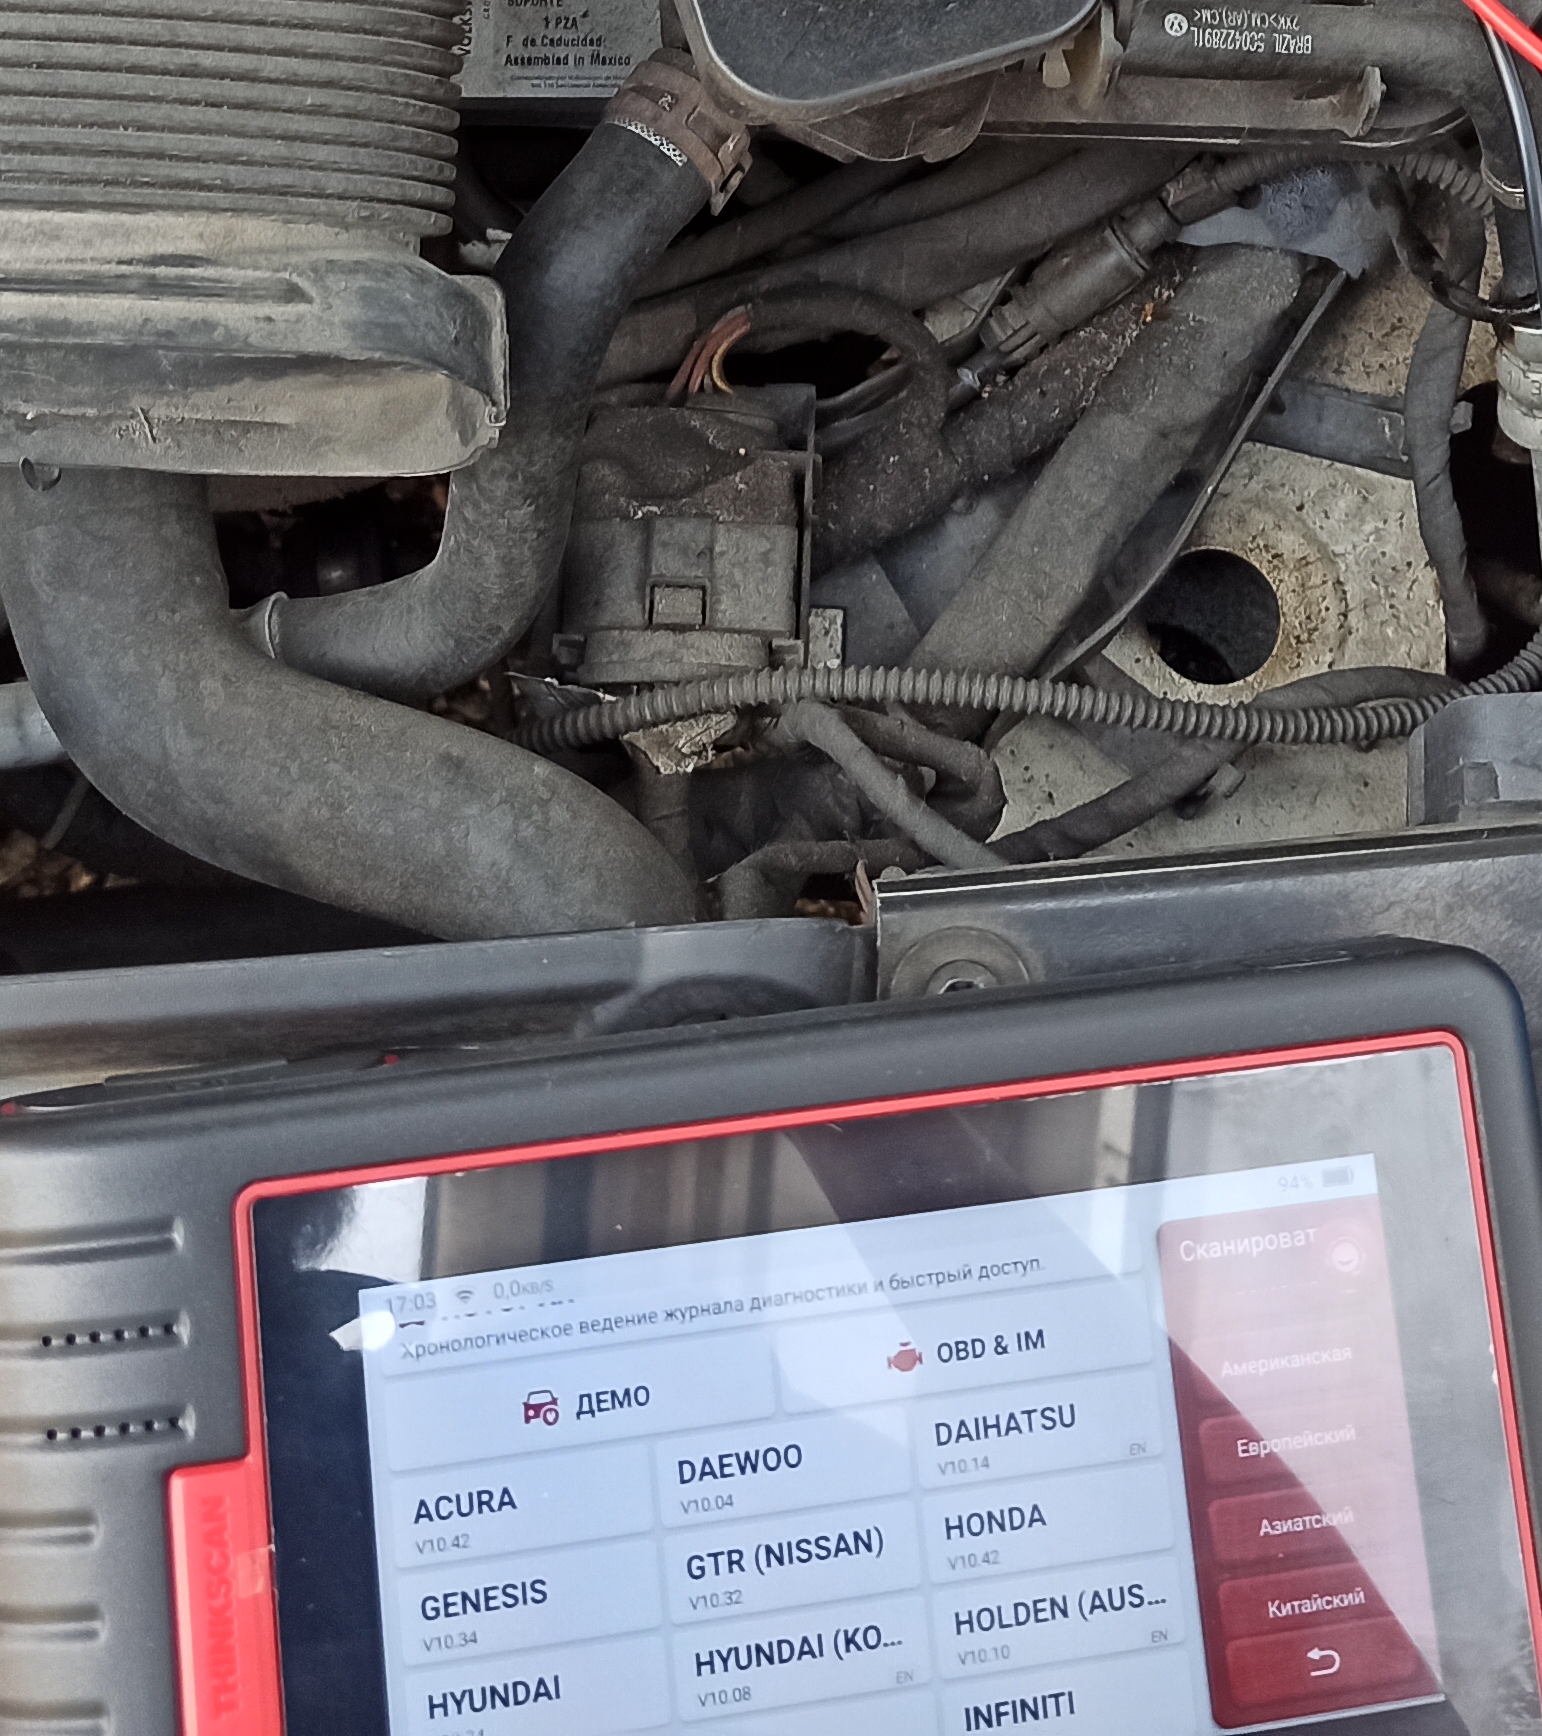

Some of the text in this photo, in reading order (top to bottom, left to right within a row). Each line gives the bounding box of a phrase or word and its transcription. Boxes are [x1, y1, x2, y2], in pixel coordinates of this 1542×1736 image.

[555, 16, 579, 31] PZA
[522, 35, 537, 47] de
[1272, 33, 1312, 54] BRAZIL
[504, 54, 569, 67] Assembled
[590, 53, 631, 67] Mexico
[385, 1291, 437, 1314] 17:03
[400, 1321, 573, 1361] Хронологическое
[579, 1311, 659, 1336] ведение
[662, 1298, 744, 1325] журнала
[749, 1281, 869, 1313] диагностики
[873, 1278, 885, 1292] и
[888, 1265, 974, 1290] быстрый
[936, 1328, 1046, 1364] OBD & IM
[1221, 1346, 1353, 1378] Американская
[575, 1384, 651, 1420] ДЕМО
[934, 1403, 1077, 1447] DAIHATSU
[1129, 1441, 1148, 1456] EN
[1236, 1424, 1356, 1458] Европейский
[678, 1443, 803, 1485] DAEWOO
[937, 1455, 991, 1477] V10.14
[413, 1486, 518, 1525] ACURA
[680, 1494, 734, 1515] V10.04
[944, 1503, 1048, 1540] HONDA
[1259, 1506, 1354, 1537] Азиатский
[415, 1533, 471, 1555] V10.42
[686, 1526, 884, 1580] GTR (NISSAN)
[946, 1549, 1001, 1570] V10.42
[201, 1495, 241, 1721] THINKSCAN
[420, 1578, 548, 1621] GENESIS
[688, 1589, 743, 1610] V10.32
[954, 1595, 1070, 1635] HOLDEN
[1268, 1587, 1366, 1619] Китайский
[423, 1630, 479, 1652] V10.34
[1150, 1629, 1169, 1644] EN
[695, 1633, 825, 1677] HYUNDAI
[957, 1644, 1010, 1665] V10.10
[895, 1669, 915, 1685] EN
[427, 1674, 562, 1720] HYUNDAI
[697, 1686, 752, 1707] V10.08
[963, 1690, 1076, 1732] INFINITI
